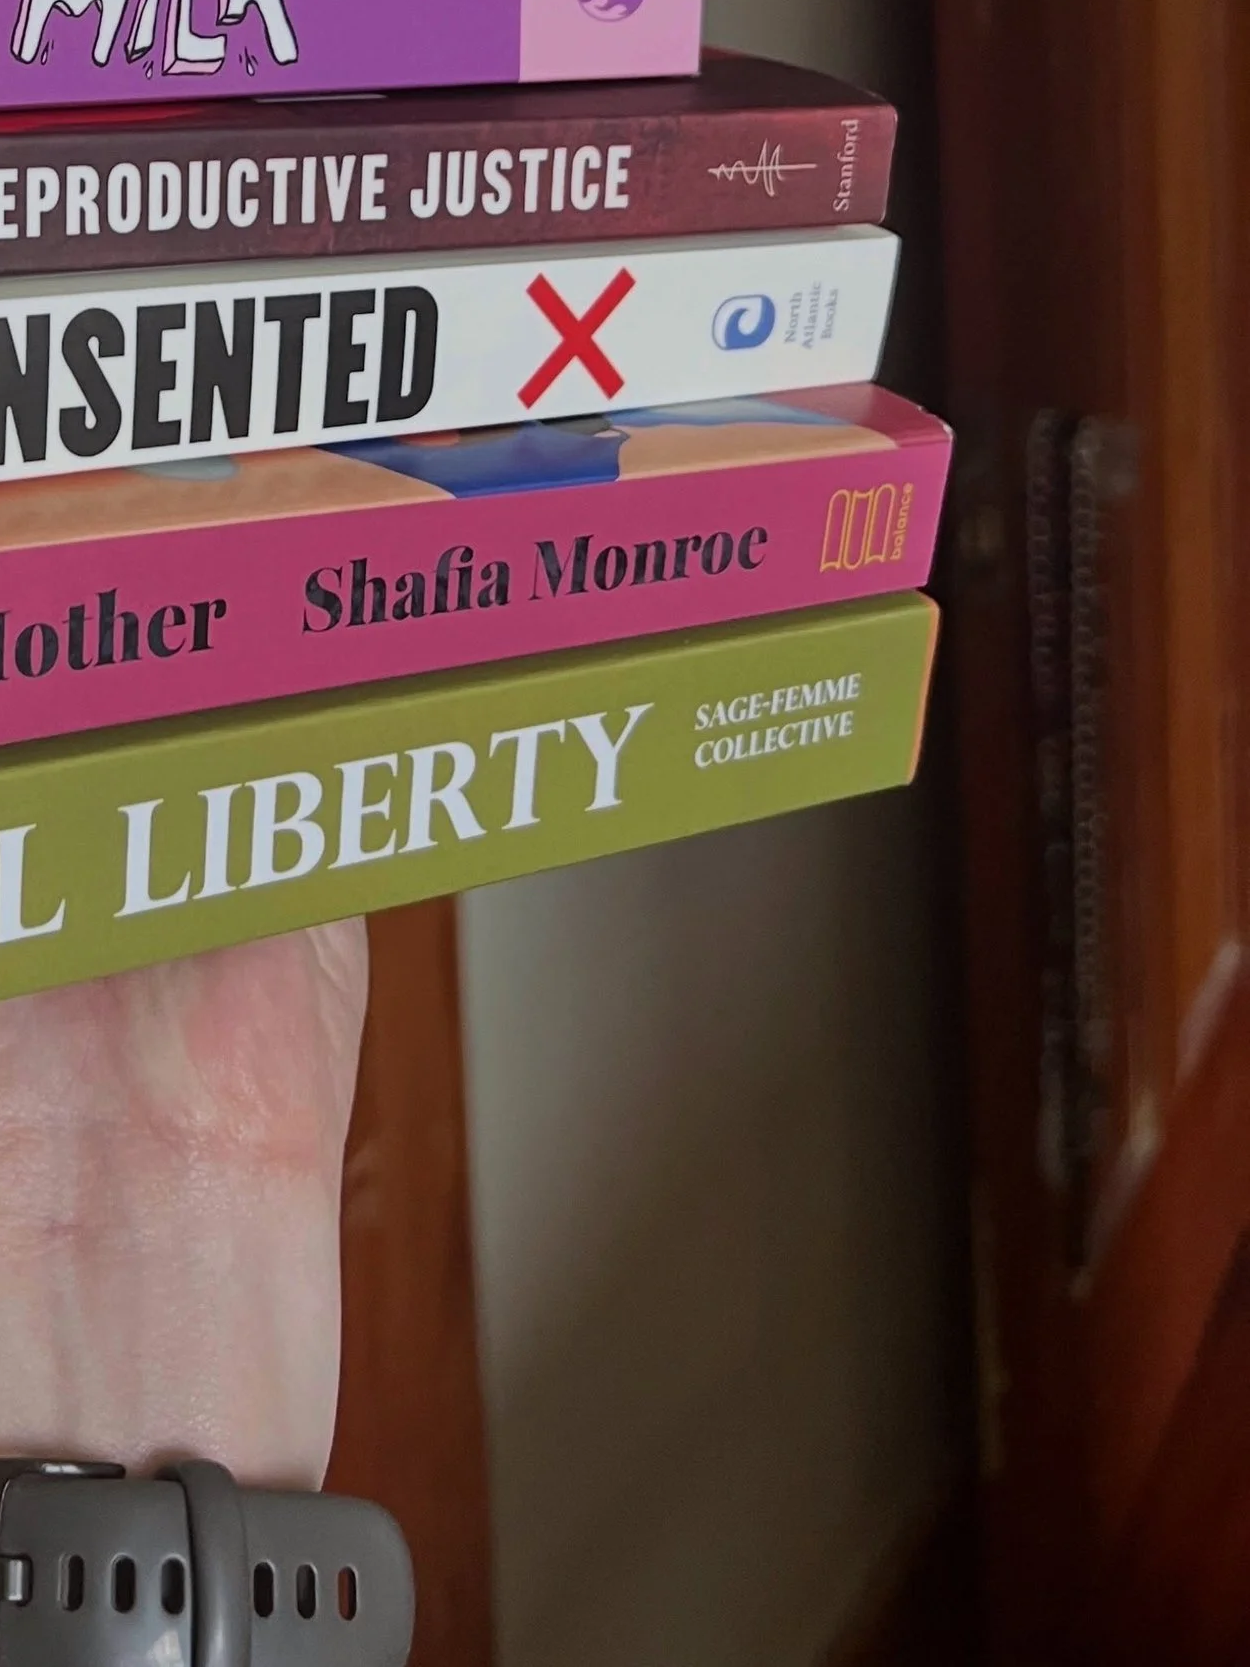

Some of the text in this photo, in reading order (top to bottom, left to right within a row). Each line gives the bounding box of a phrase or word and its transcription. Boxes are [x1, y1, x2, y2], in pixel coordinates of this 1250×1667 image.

[409, 144, 633, 220] JUSTICE
[833, 118, 859, 212] Stanford
[783, 291, 803, 344] North
[801, 281, 822, 350] Atlantic
[820, 288, 839, 340] Books
[890, 482, 914, 561] balance
[301, 525, 769, 637] Shafia Monroe
[693, 672, 863, 732] SAGE-FEMME
[693, 710, 855, 770] COLLECTIVE
[112, 702, 655, 918] LIBERTY
